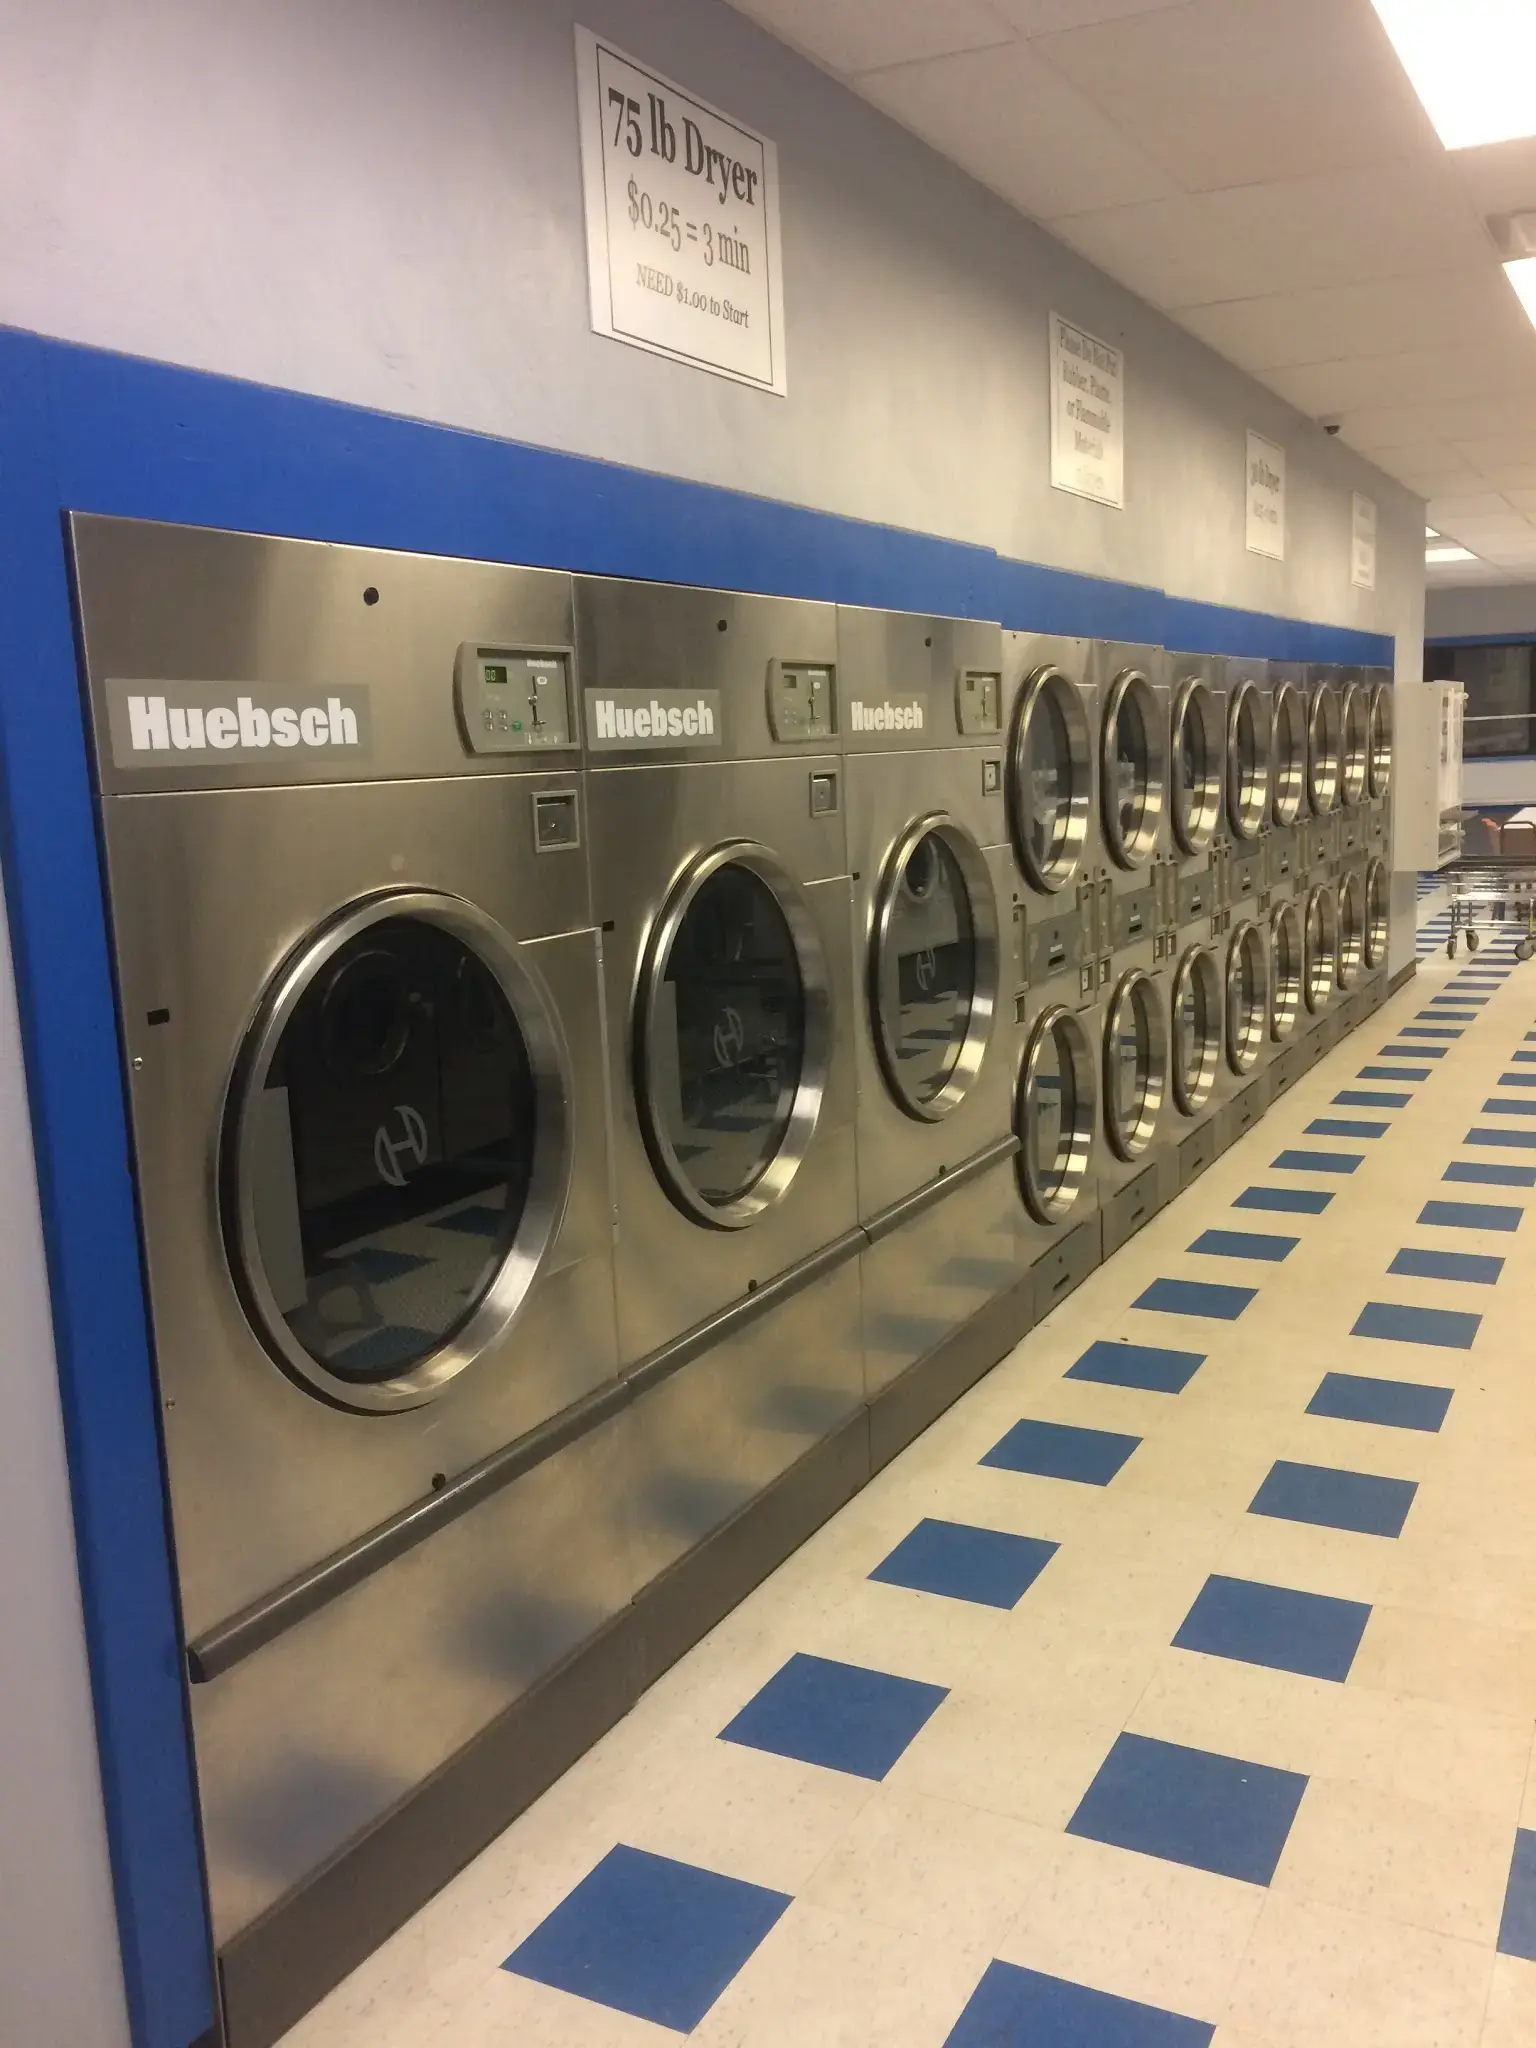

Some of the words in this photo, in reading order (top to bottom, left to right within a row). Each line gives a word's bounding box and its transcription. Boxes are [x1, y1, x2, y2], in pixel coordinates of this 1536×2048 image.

[608, 86, 643, 158] 75
[648, 92, 676, 163] lb
[682, 116, 758, 205] Dryer
[628, 174, 681, 252] $0.25
[686, 222, 698, 242] =
[703, 223, 713, 266] 3
[718, 226, 751, 274] min
[636, 262, 674, 297] NEED
[676, 280, 707, 312] $1.00
[710, 295, 721, 316] to
[723, 298, 749, 329] Start
[127, 696, 359, 750] Huebsch
[595, 700, 714, 738] Huebsch
[851, 701, 923, 731] Huebsch
